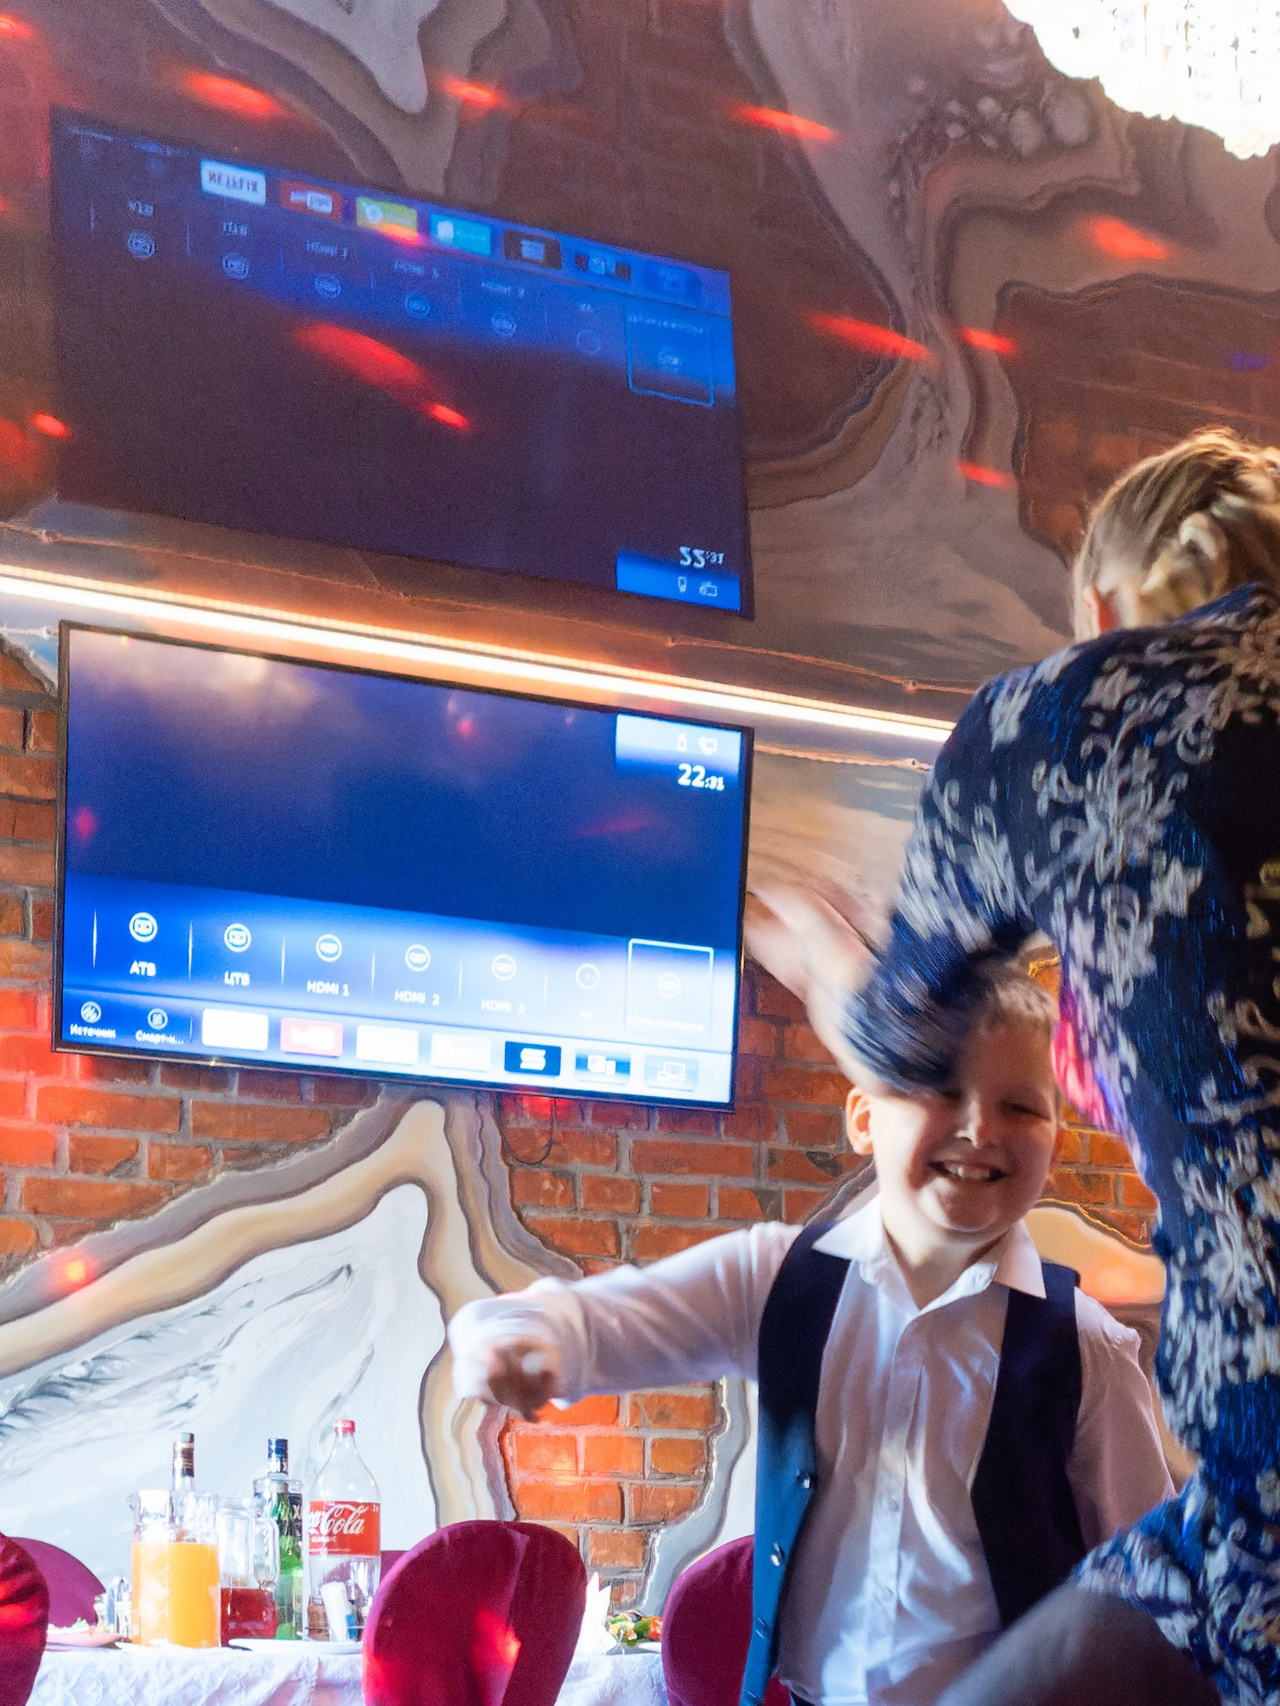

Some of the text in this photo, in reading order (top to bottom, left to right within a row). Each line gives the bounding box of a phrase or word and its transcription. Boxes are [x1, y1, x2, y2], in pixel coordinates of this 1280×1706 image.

[677, 763, 725, 791] 22:31
[224, 971, 250, 987] ЦТВ
[307, 980, 350, 997] HDMI 1
[394, 989, 441, 1007] HDMI 2
[481, 998, 527, 1015] HDMI 3
